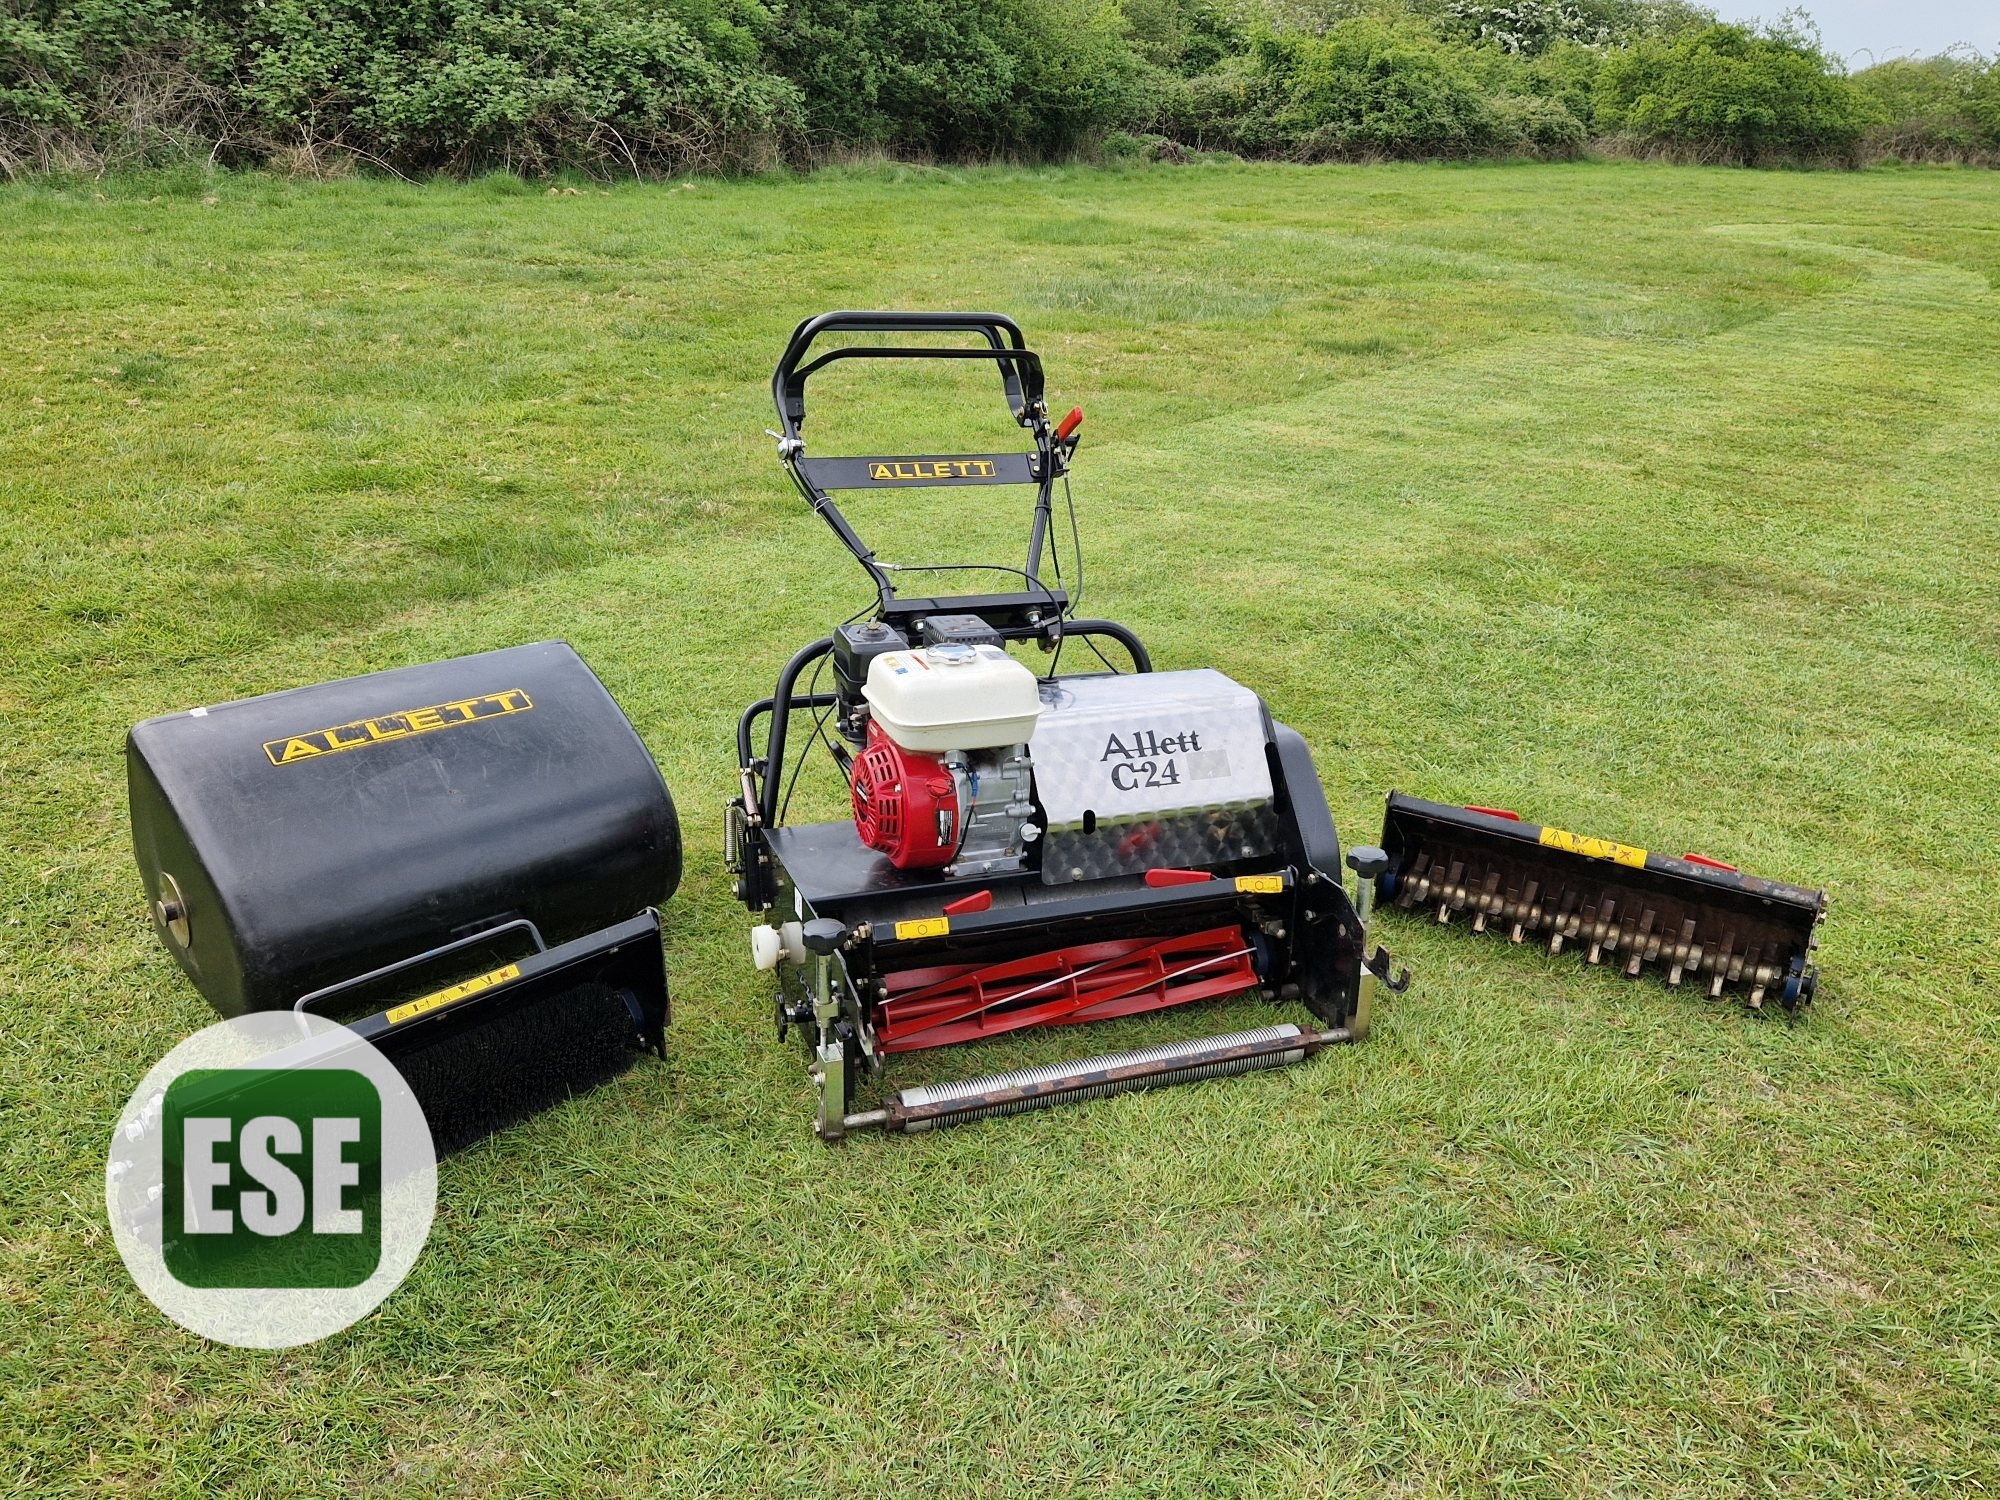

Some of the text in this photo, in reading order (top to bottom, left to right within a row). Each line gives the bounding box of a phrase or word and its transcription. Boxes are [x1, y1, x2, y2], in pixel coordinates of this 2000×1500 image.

[874, 462, 991, 478] ALLETT
[281, 692, 517, 761] ALLETT
[1100, 729, 1202, 761] Allett
[1111, 758, 1181, 791] C24
